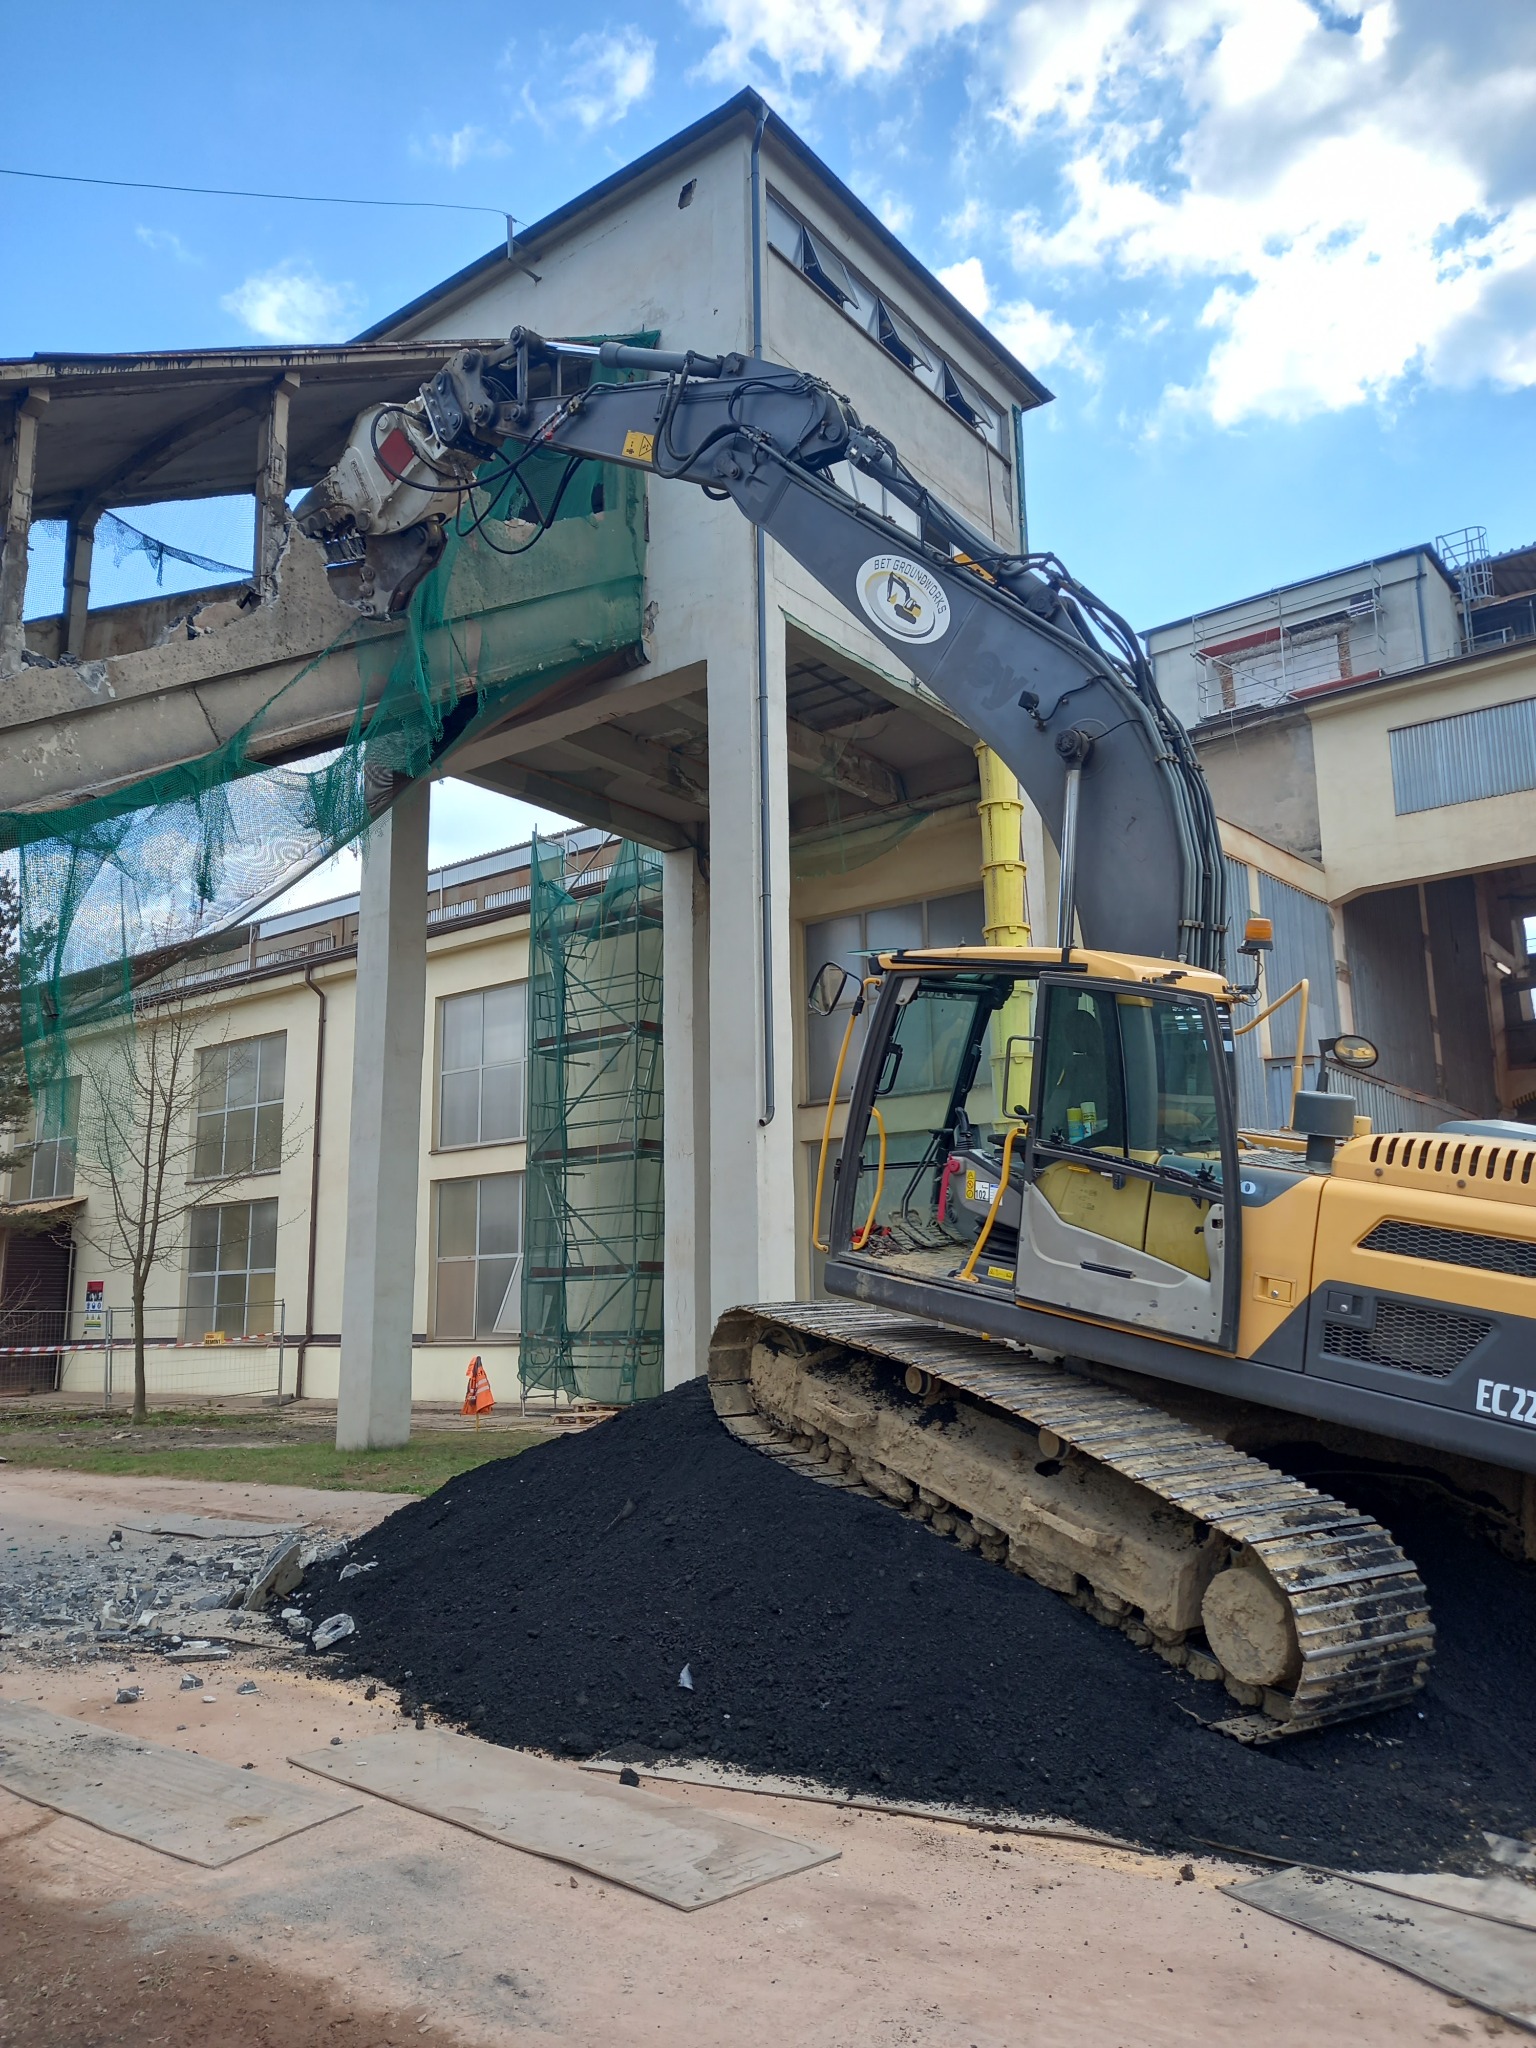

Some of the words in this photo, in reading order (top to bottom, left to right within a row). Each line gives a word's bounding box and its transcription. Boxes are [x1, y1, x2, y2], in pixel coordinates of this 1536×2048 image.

[874, 558, 892, 570] BET
[892, 559, 947, 615] GROUNDWORKS
[975, 1189, 986, 1200] 102
